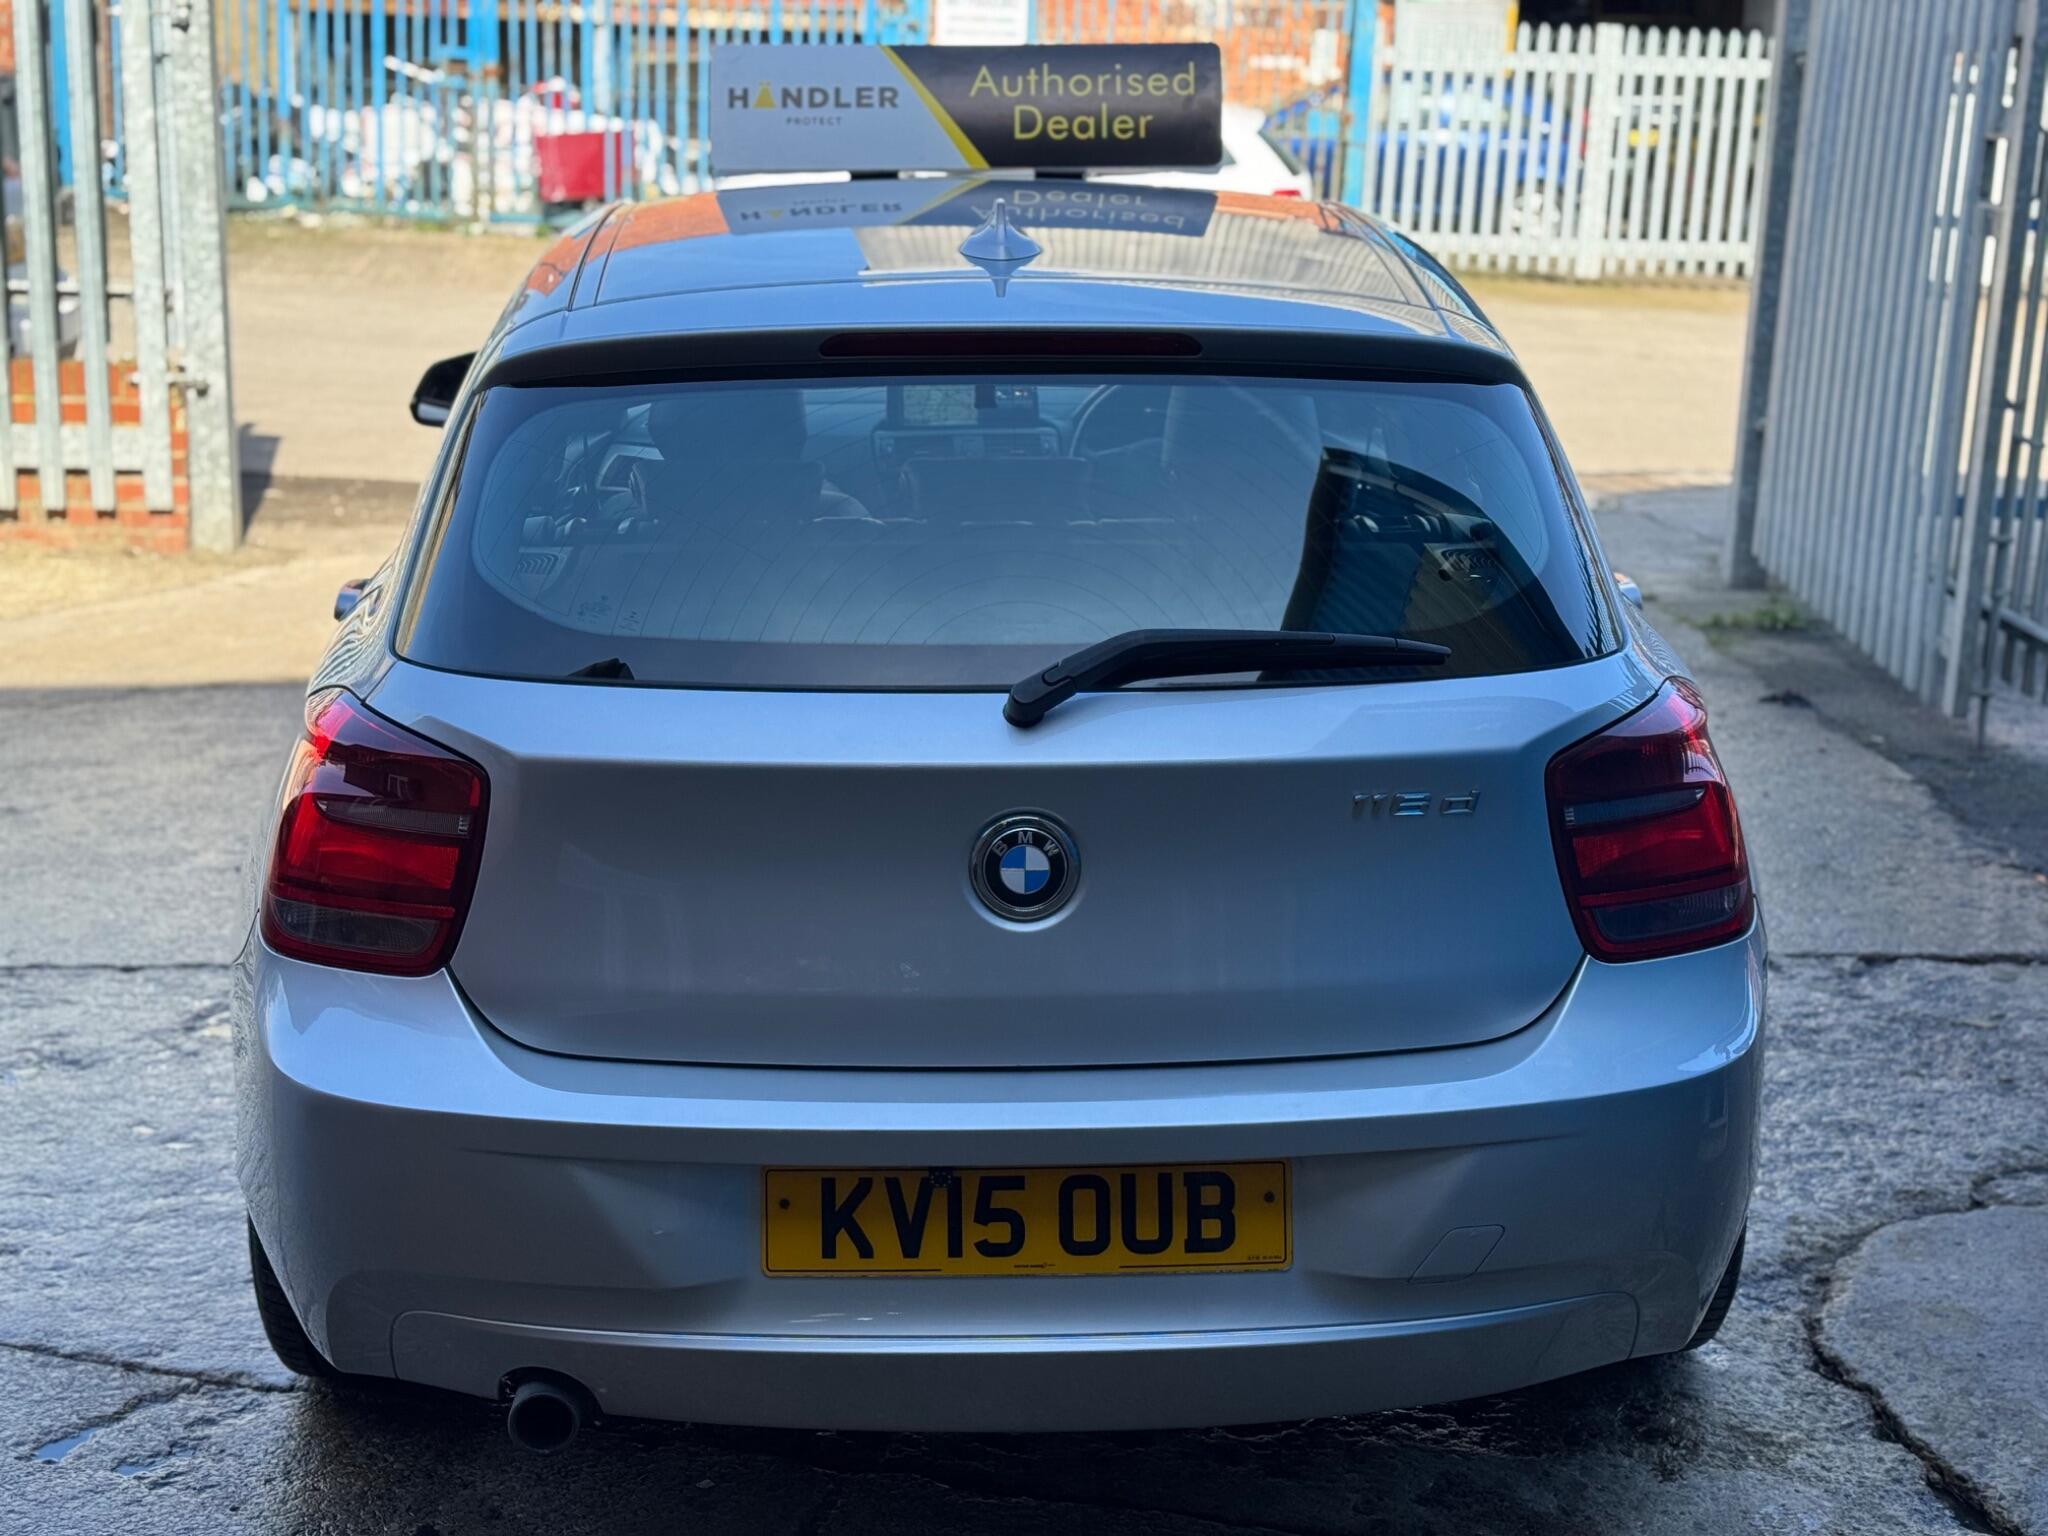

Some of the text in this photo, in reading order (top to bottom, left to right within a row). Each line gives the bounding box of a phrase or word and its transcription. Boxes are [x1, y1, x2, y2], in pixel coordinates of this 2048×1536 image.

[969, 61, 1196, 97] Authorised
[786, 116, 842, 126] PROTECT
[1013, 102, 1154, 140] Dealer
[992, 831, 1060, 857] BMW
[821, 1171, 1236, 1259] KV15 OUB
